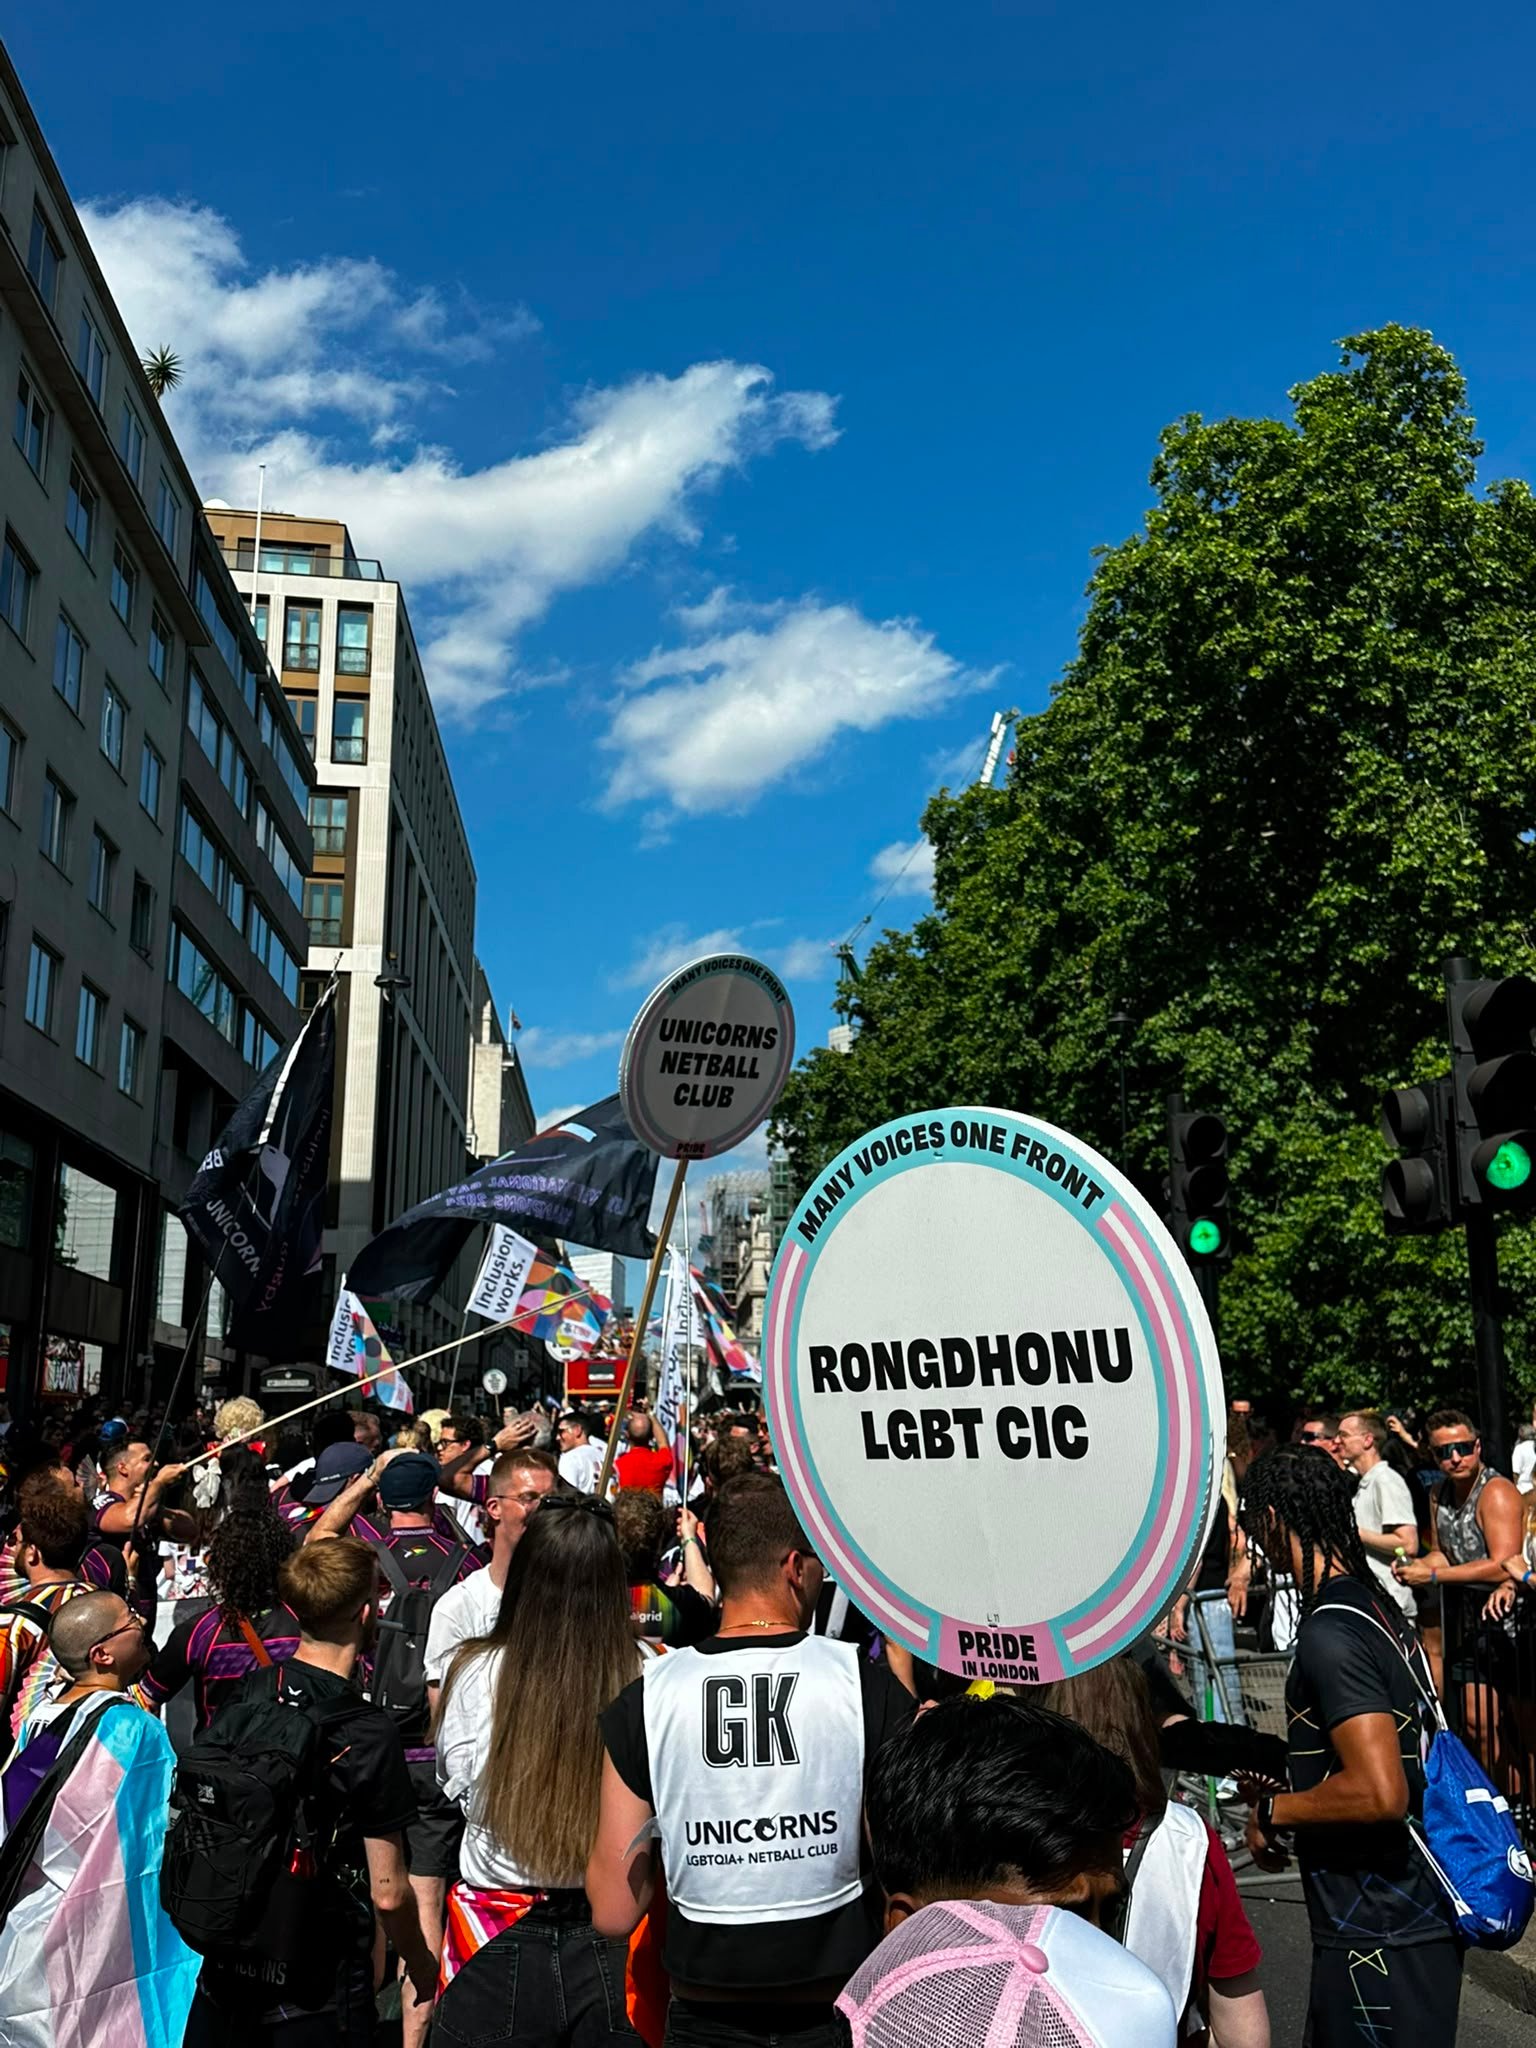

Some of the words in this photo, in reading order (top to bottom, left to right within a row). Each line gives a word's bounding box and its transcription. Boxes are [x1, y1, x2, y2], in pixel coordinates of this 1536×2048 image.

[670, 967, 703, 994] MANY
[703, 958, 742, 973] VOICES
[743, 961, 763, 979] ONE
[761, 972, 786, 1003] FRONT
[659, 1018, 778, 1050] UNICORNS
[659, 1050, 760, 1079] NETBALL
[673, 1083, 735, 1108] CLUB
[797, 1160, 856, 1244] MANY
[852, 1121, 946, 1176] VOICES
[950, 1119, 1006, 1154] ONE
[1010, 1133, 1106, 1210] FRONT
[475, 1233, 515, 1309] Inclusion
[495, 1258, 526, 1314] works.
[808, 1327, 1134, 1394] RONGDHONU
[860, 1407, 984, 1460] LGBT
[995, 1404, 1090, 1460] CIC
[962, 1660, 977, 1677] IN
[980, 1662, 1040, 1682] LONDON
[702, 1672, 800, 1768] GK
[685, 1811, 838, 1846] UNICORNS
[686, 1852, 745, 1867] LGBTQIA+
[748, 1849, 806, 1865] NETBALL
[807, 1843, 838, 1859] CLUB
